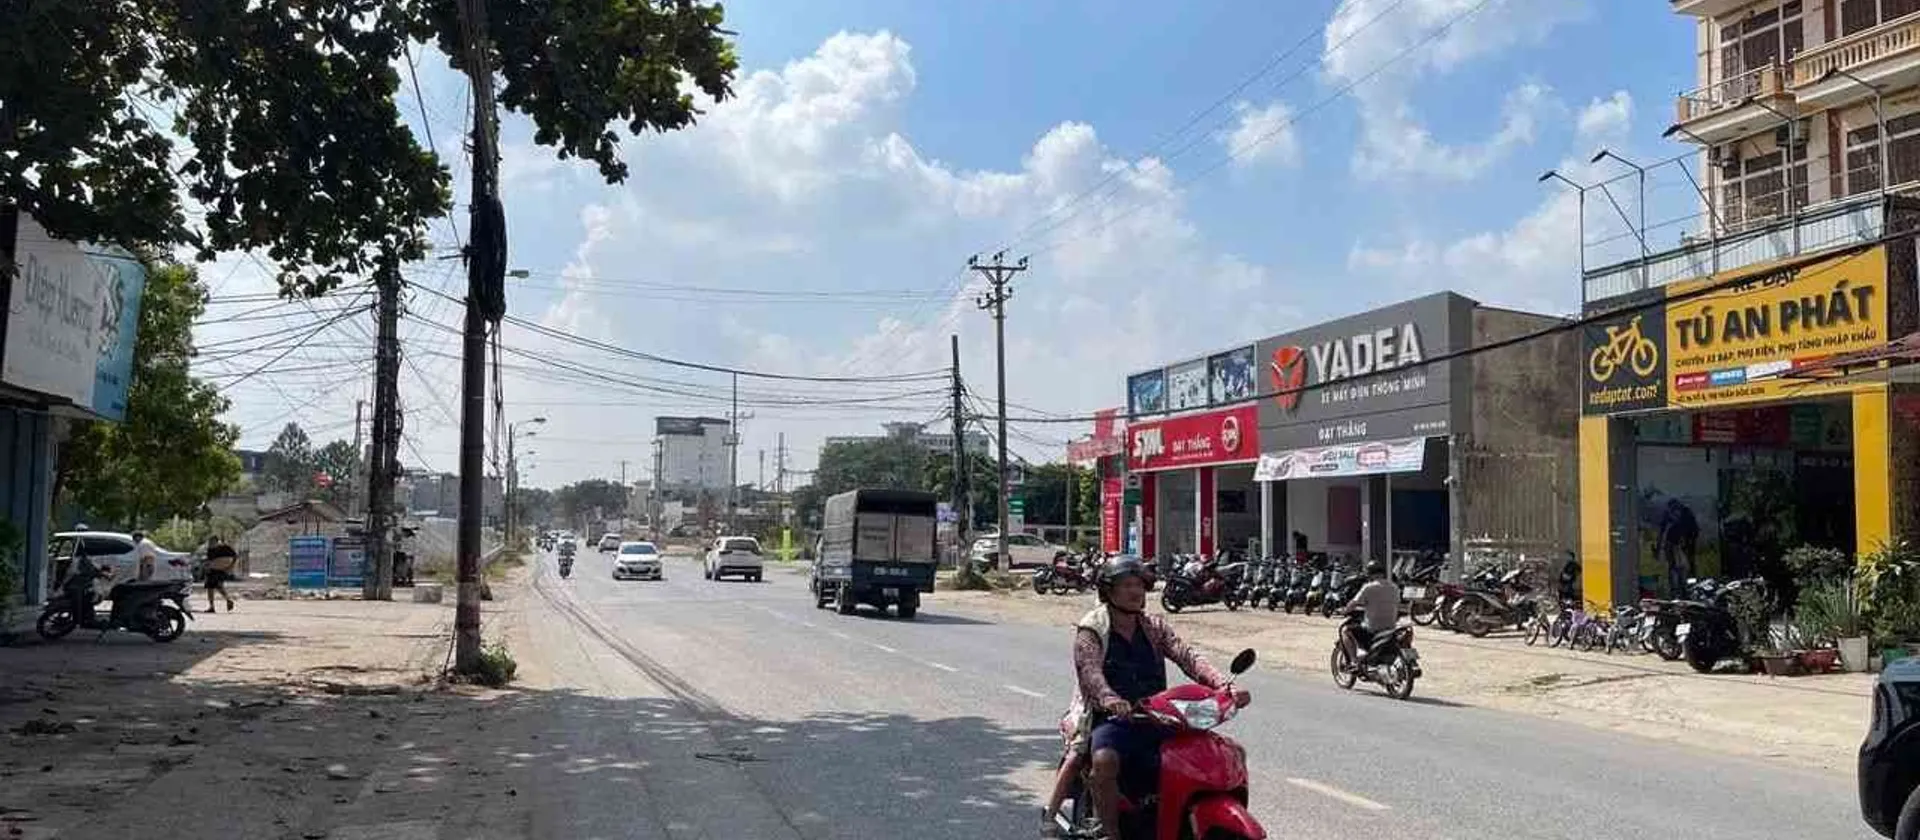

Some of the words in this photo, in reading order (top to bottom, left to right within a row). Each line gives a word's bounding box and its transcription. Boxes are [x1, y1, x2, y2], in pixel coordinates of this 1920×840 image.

[1675, 305, 1715, 350] TÚ
[1722, 304, 1771, 343] AN
[1779, 279, 1875, 335] PHÁT
[1311, 322, 1424, 385] YADEA
